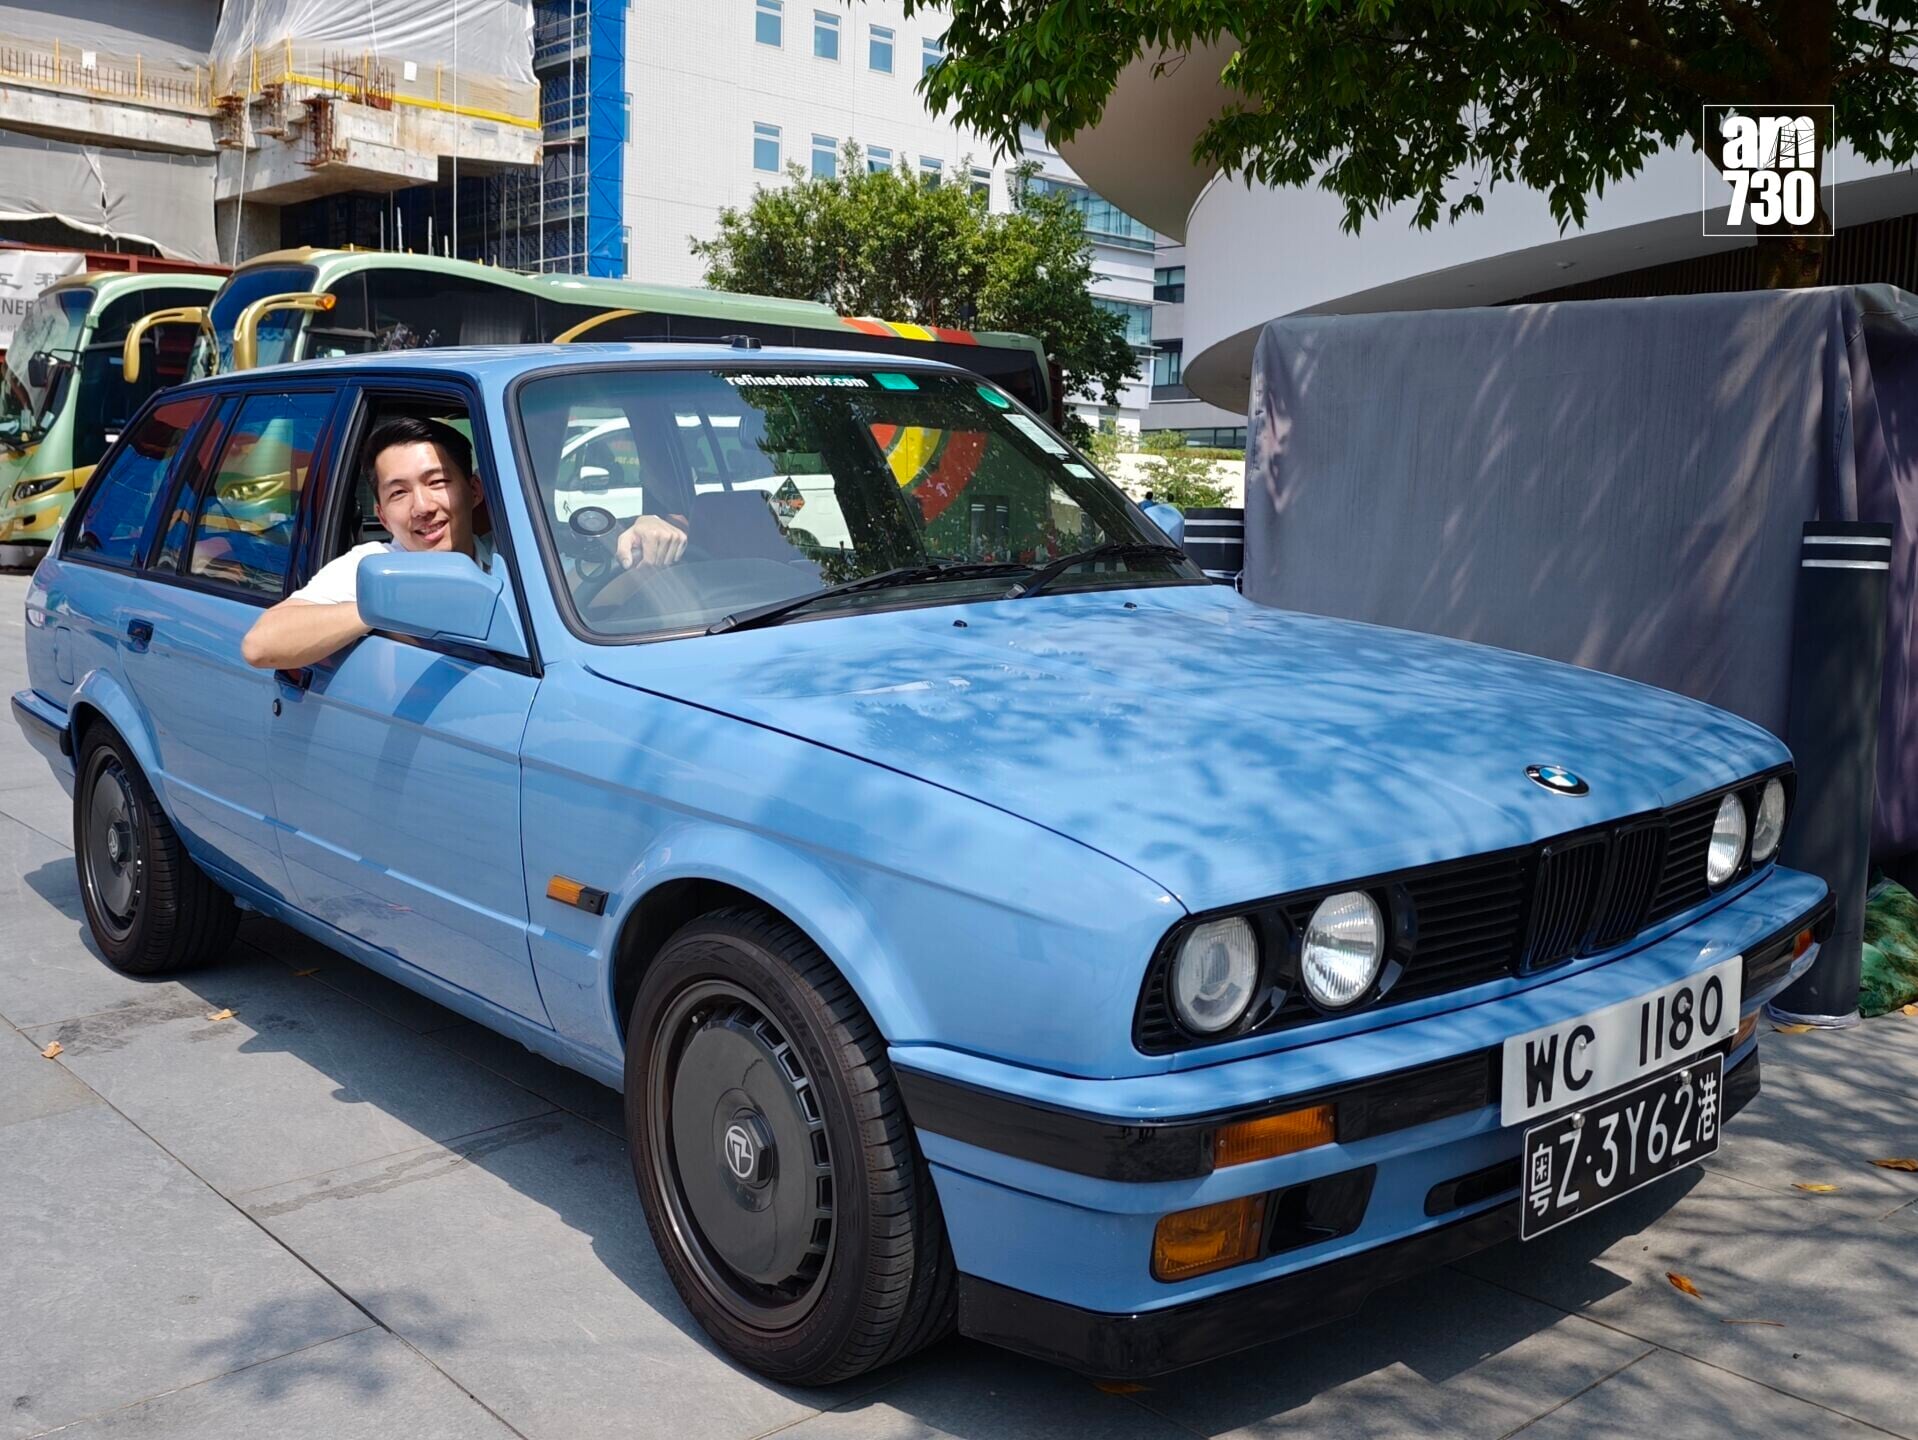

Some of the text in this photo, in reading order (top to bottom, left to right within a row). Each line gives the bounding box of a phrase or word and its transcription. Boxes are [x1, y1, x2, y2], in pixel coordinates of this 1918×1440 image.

[724, 374, 870, 388] refinedmotor.com
[1525, 975, 1724, 1108] WC 1180
